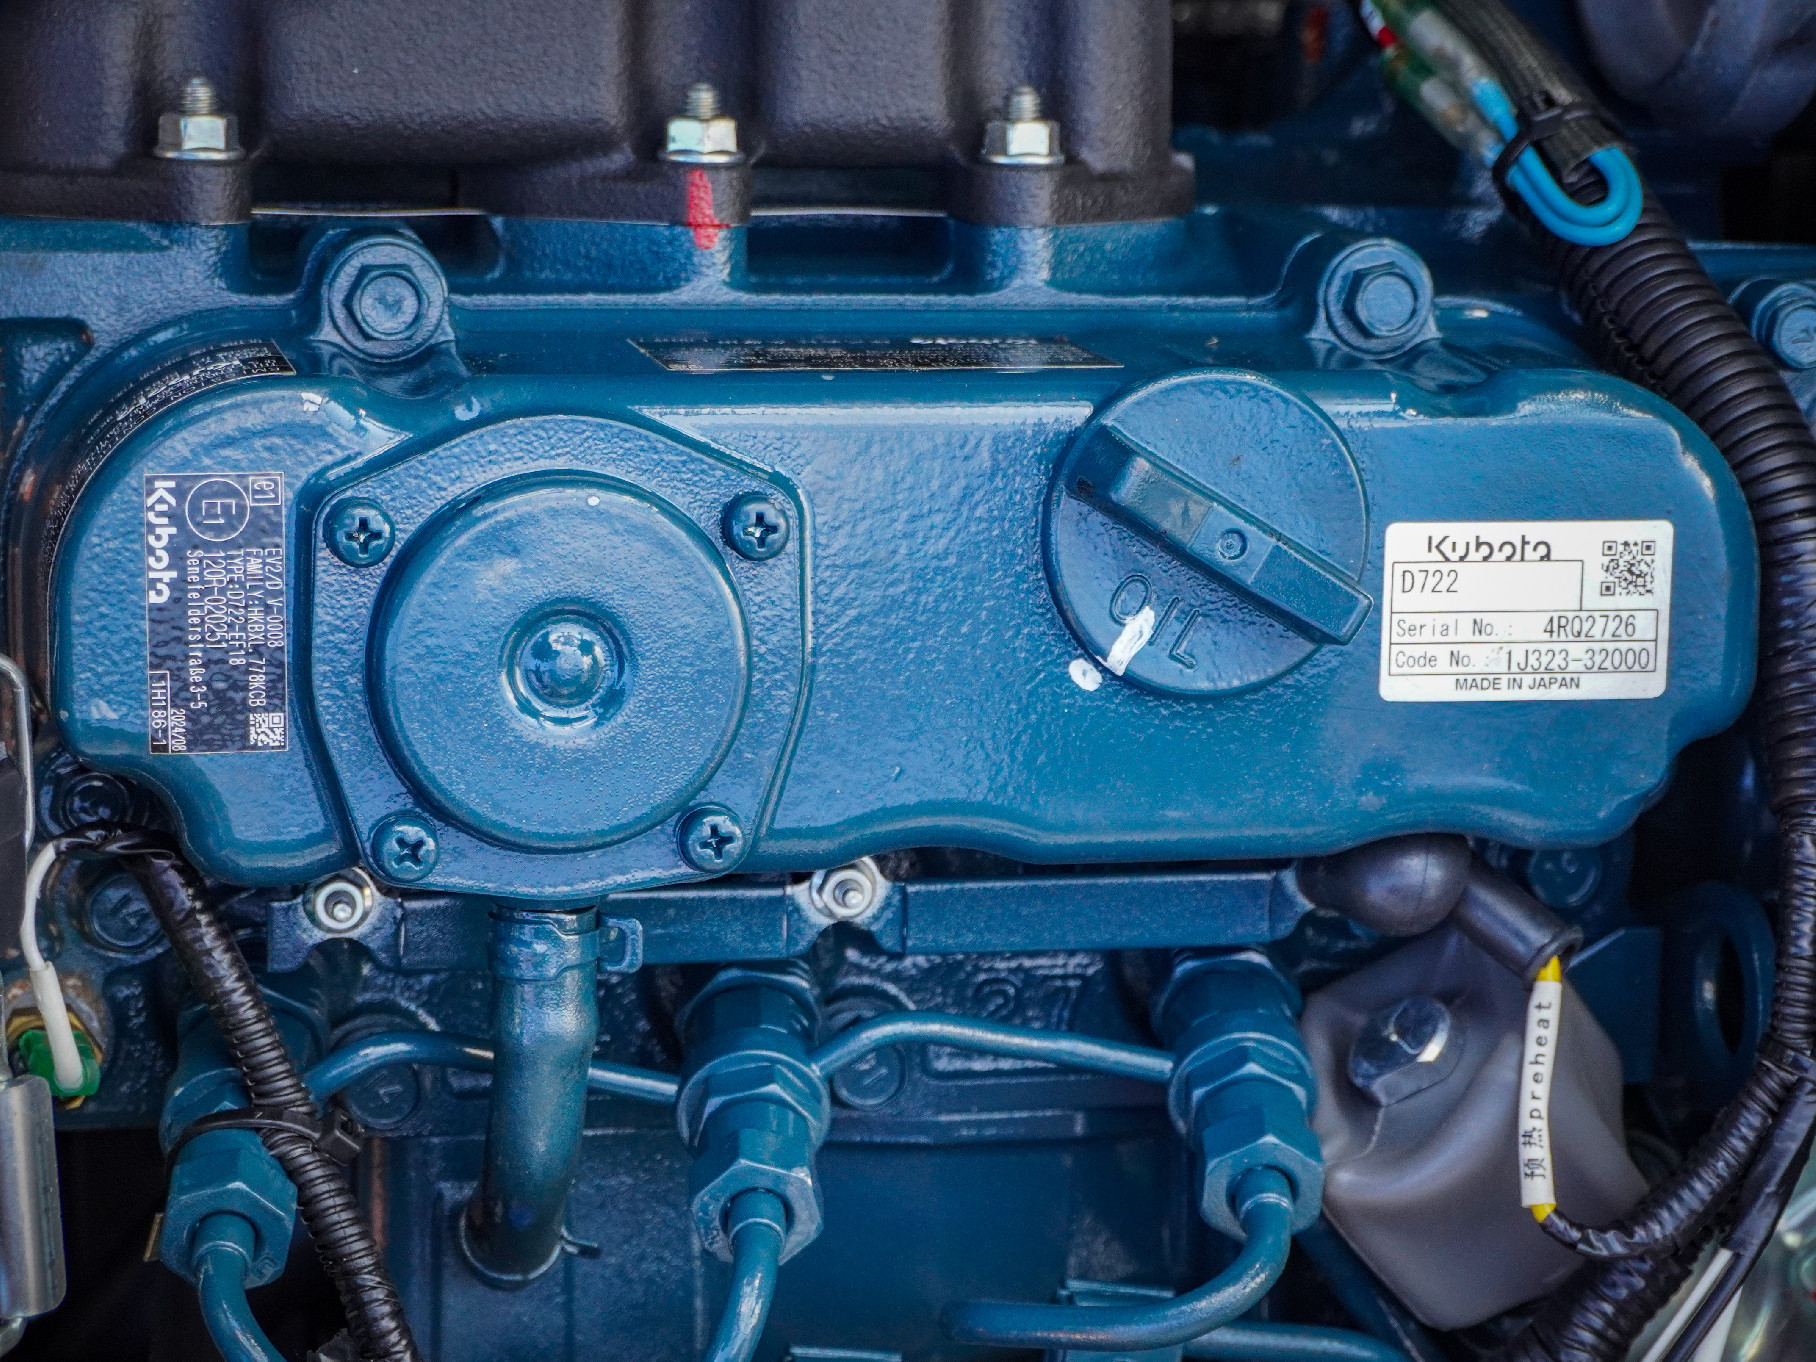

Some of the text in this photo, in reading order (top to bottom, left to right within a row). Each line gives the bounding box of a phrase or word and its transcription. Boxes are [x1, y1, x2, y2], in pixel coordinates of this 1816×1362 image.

[254, 481, 276, 501] e1
[202, 500, 236, 524] E1
[146, 480, 178, 604] Kubota
[264, 547, 285, 648] EV2/D V-0008
[1401, 569, 1459, 594] D722
[203, 550, 229, 649] 120R-020251
[1108, 573, 1200, 671] OIL
[1396, 619, 1459, 638] Serial
[1543, 615, 1636, 640] 4RQ2726
[1395, 650, 1438, 669] Code
[1505, 647, 1650, 673] 1J323-32000
[1455, 676, 1581, 691] MADE IN JAPAN
[151, 680, 167, 747] 1H186-1
[170, 708, 187, 752] 2024/08
